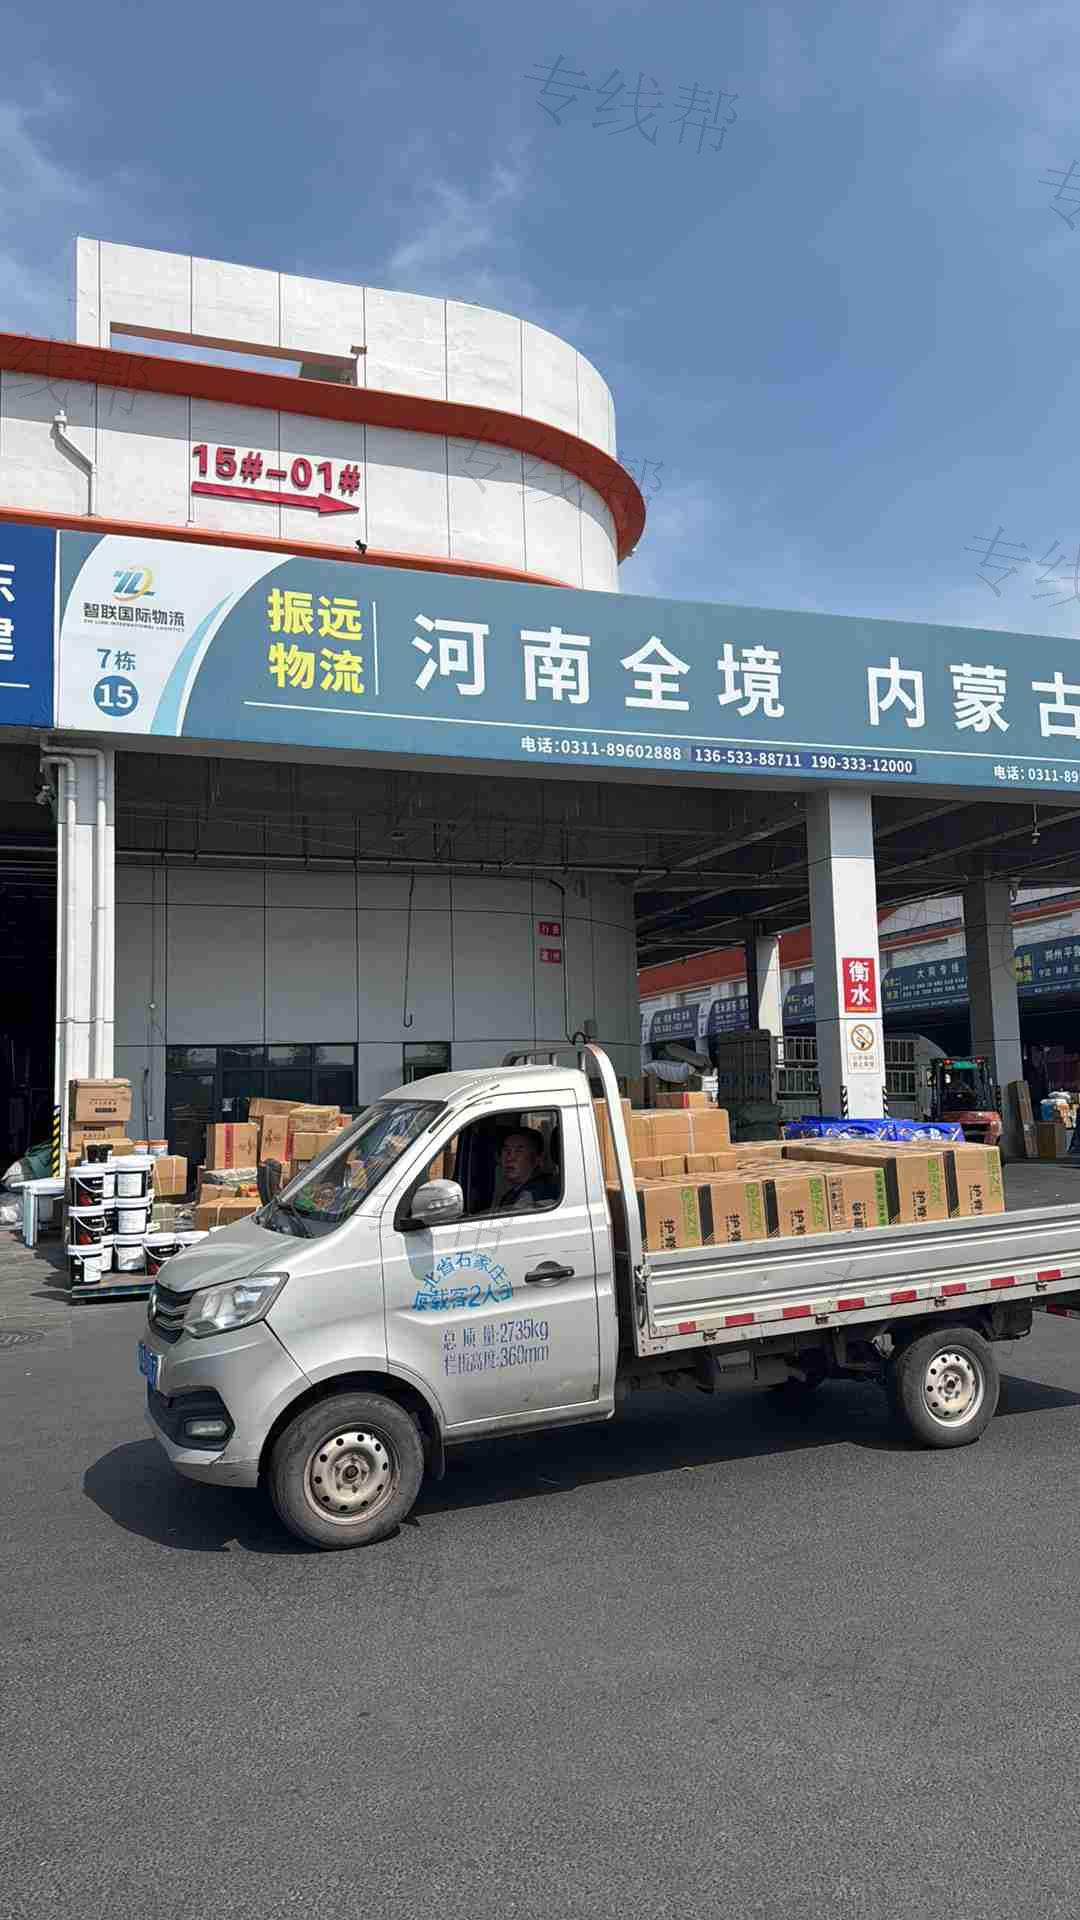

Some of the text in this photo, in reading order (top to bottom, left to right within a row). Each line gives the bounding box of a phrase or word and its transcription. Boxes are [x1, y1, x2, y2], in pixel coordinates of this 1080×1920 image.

[187, 443, 362, 496] 15#-01#
[83, 602, 185, 627] 智联国际物流
[267, 588, 363, 641] 振远
[267, 642, 365, 695] 物流
[411, 613, 1080, 740] 河南全境 内蒙古
[99, 684, 134, 708] 15
[695, 749, 801, 768] 136-533-88711
[811, 755, 913, 773] 190-333-12000
[848, 960, 872, 1006] 衡水
